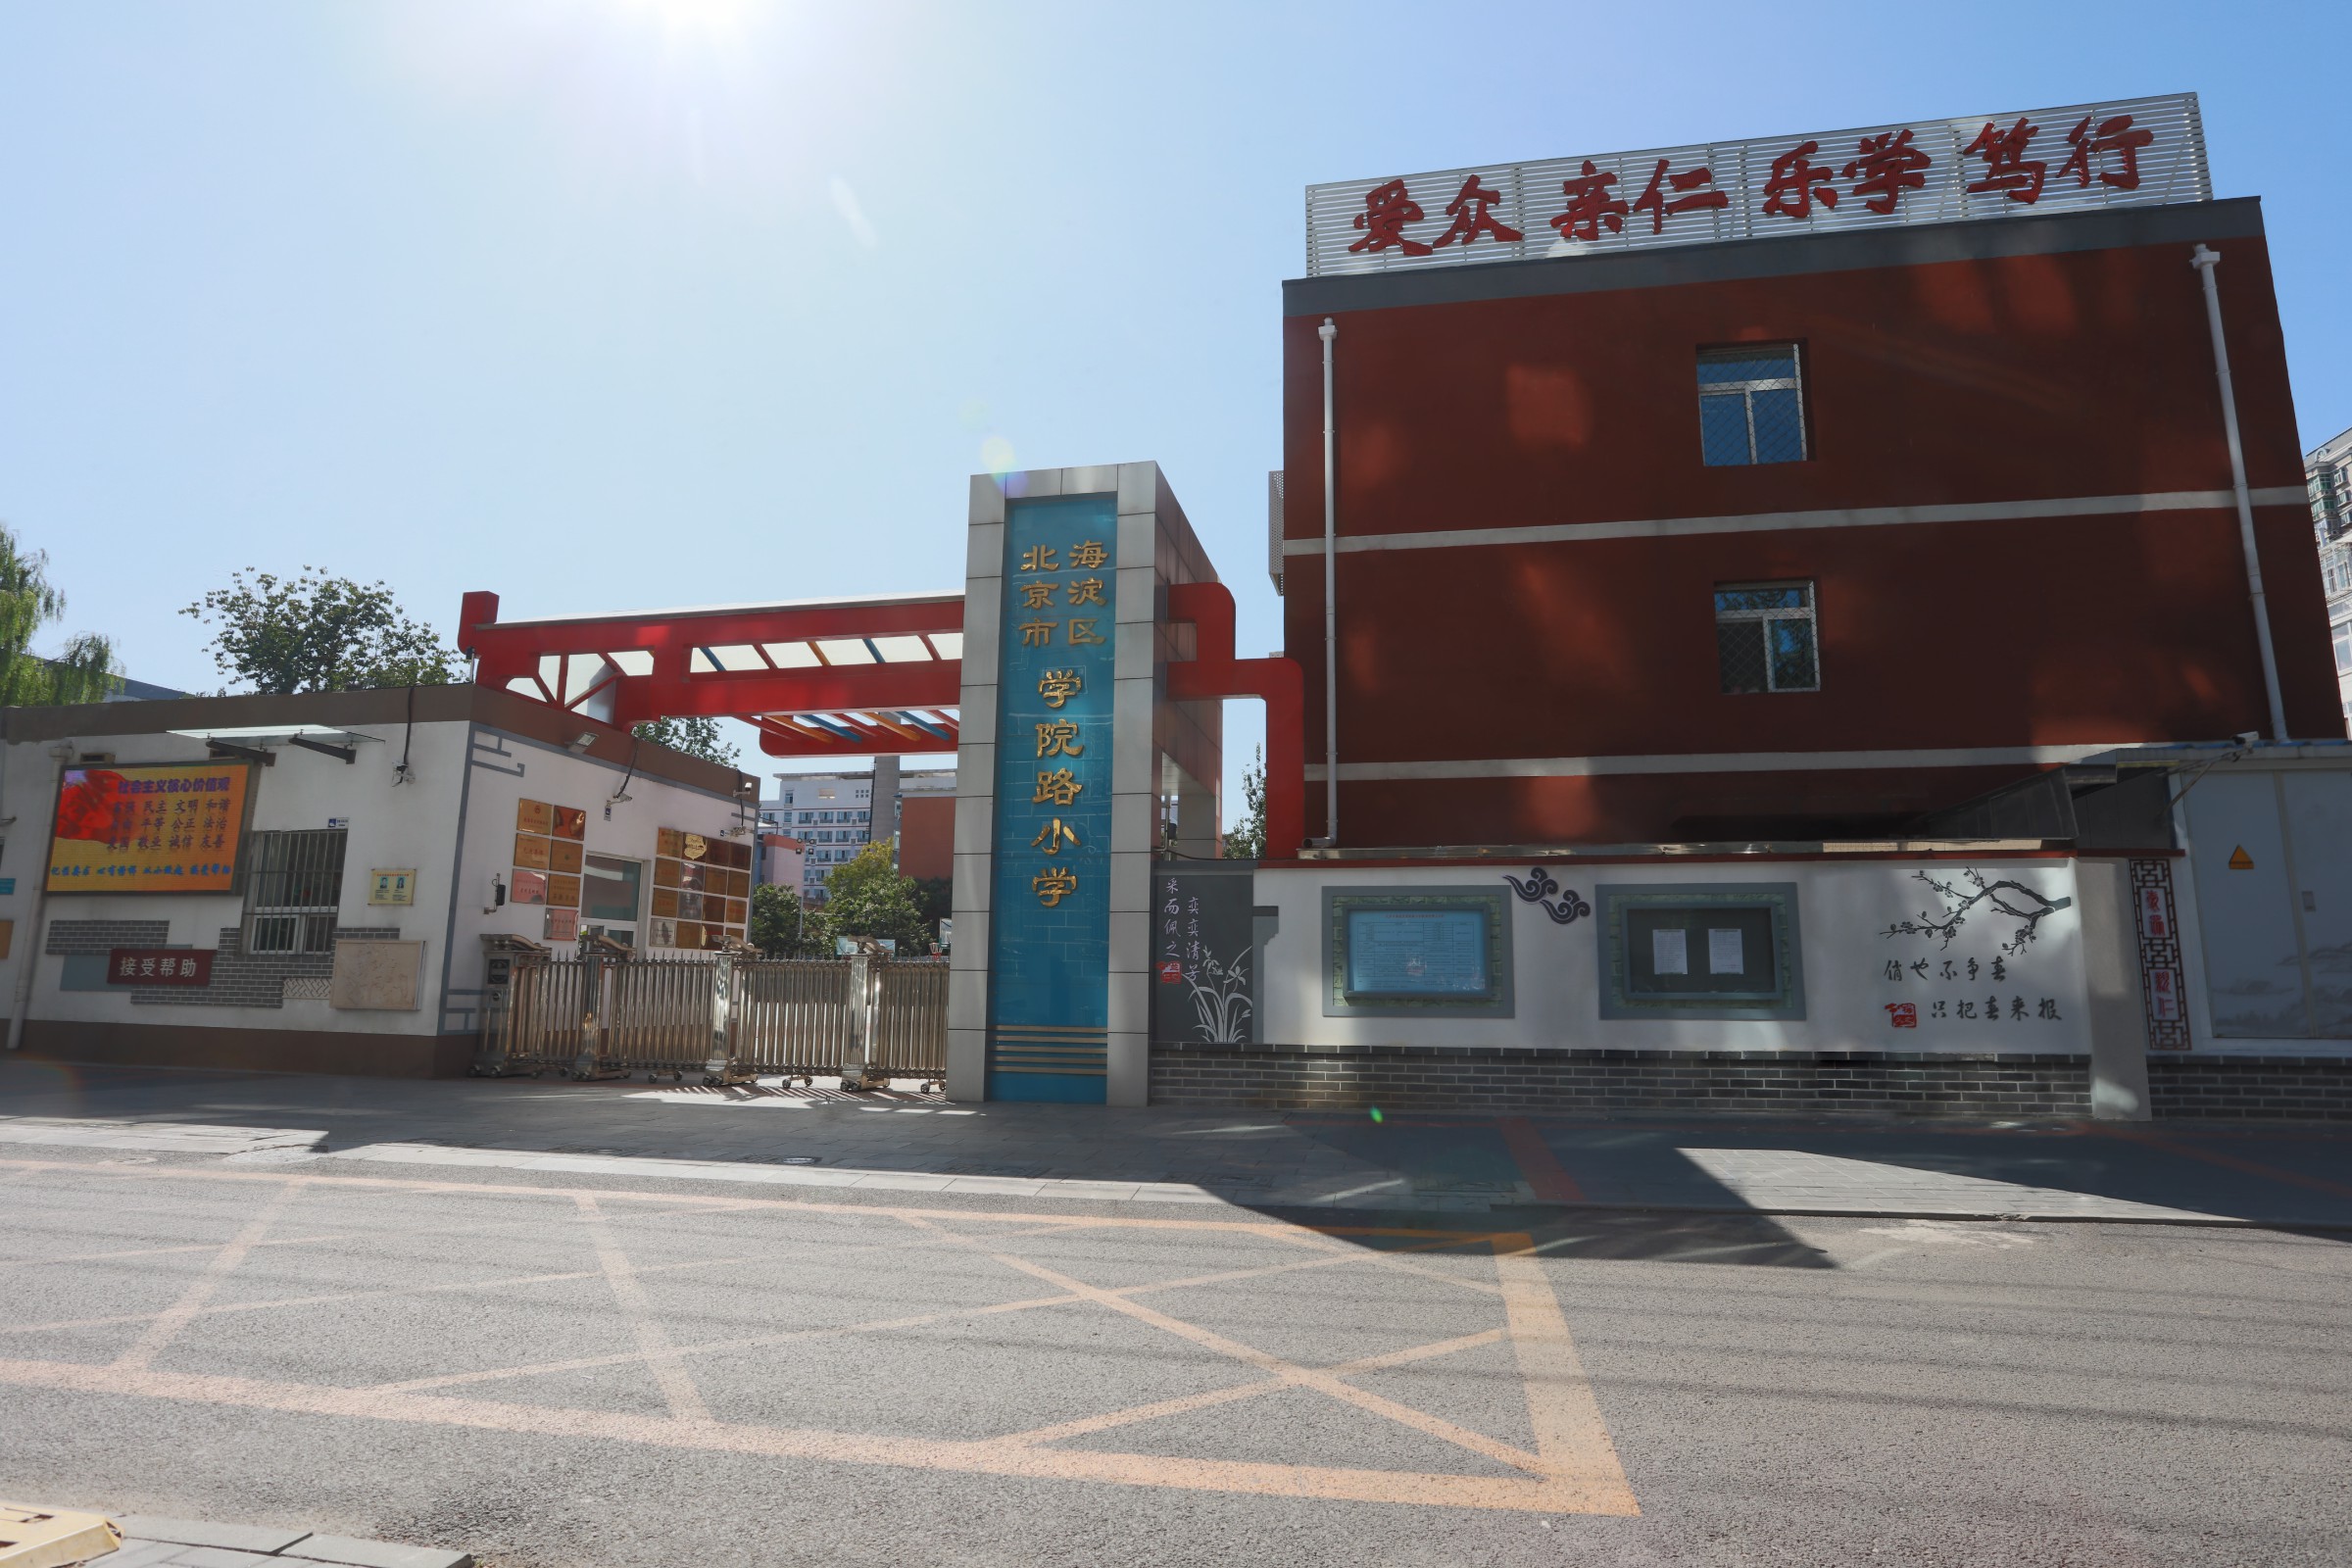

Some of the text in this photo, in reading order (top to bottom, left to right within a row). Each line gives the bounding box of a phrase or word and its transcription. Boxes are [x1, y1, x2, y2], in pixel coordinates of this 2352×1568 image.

[1348, 115, 2154, 257] 爱众 亲仁 乐学 笃行
[1018, 544, 1060, 648] 北京市
[1066, 539, 1109, 646] 海淀区
[118, 777, 230, 794] 社会主义核心价值观
[1031, 668, 1084, 907] 学院路小学
[119, 956, 197, 977] 接受帮助
[1884, 956, 2006, 982] 俏也不争春
[1931, 996, 2062, 1022] 只把春来报
